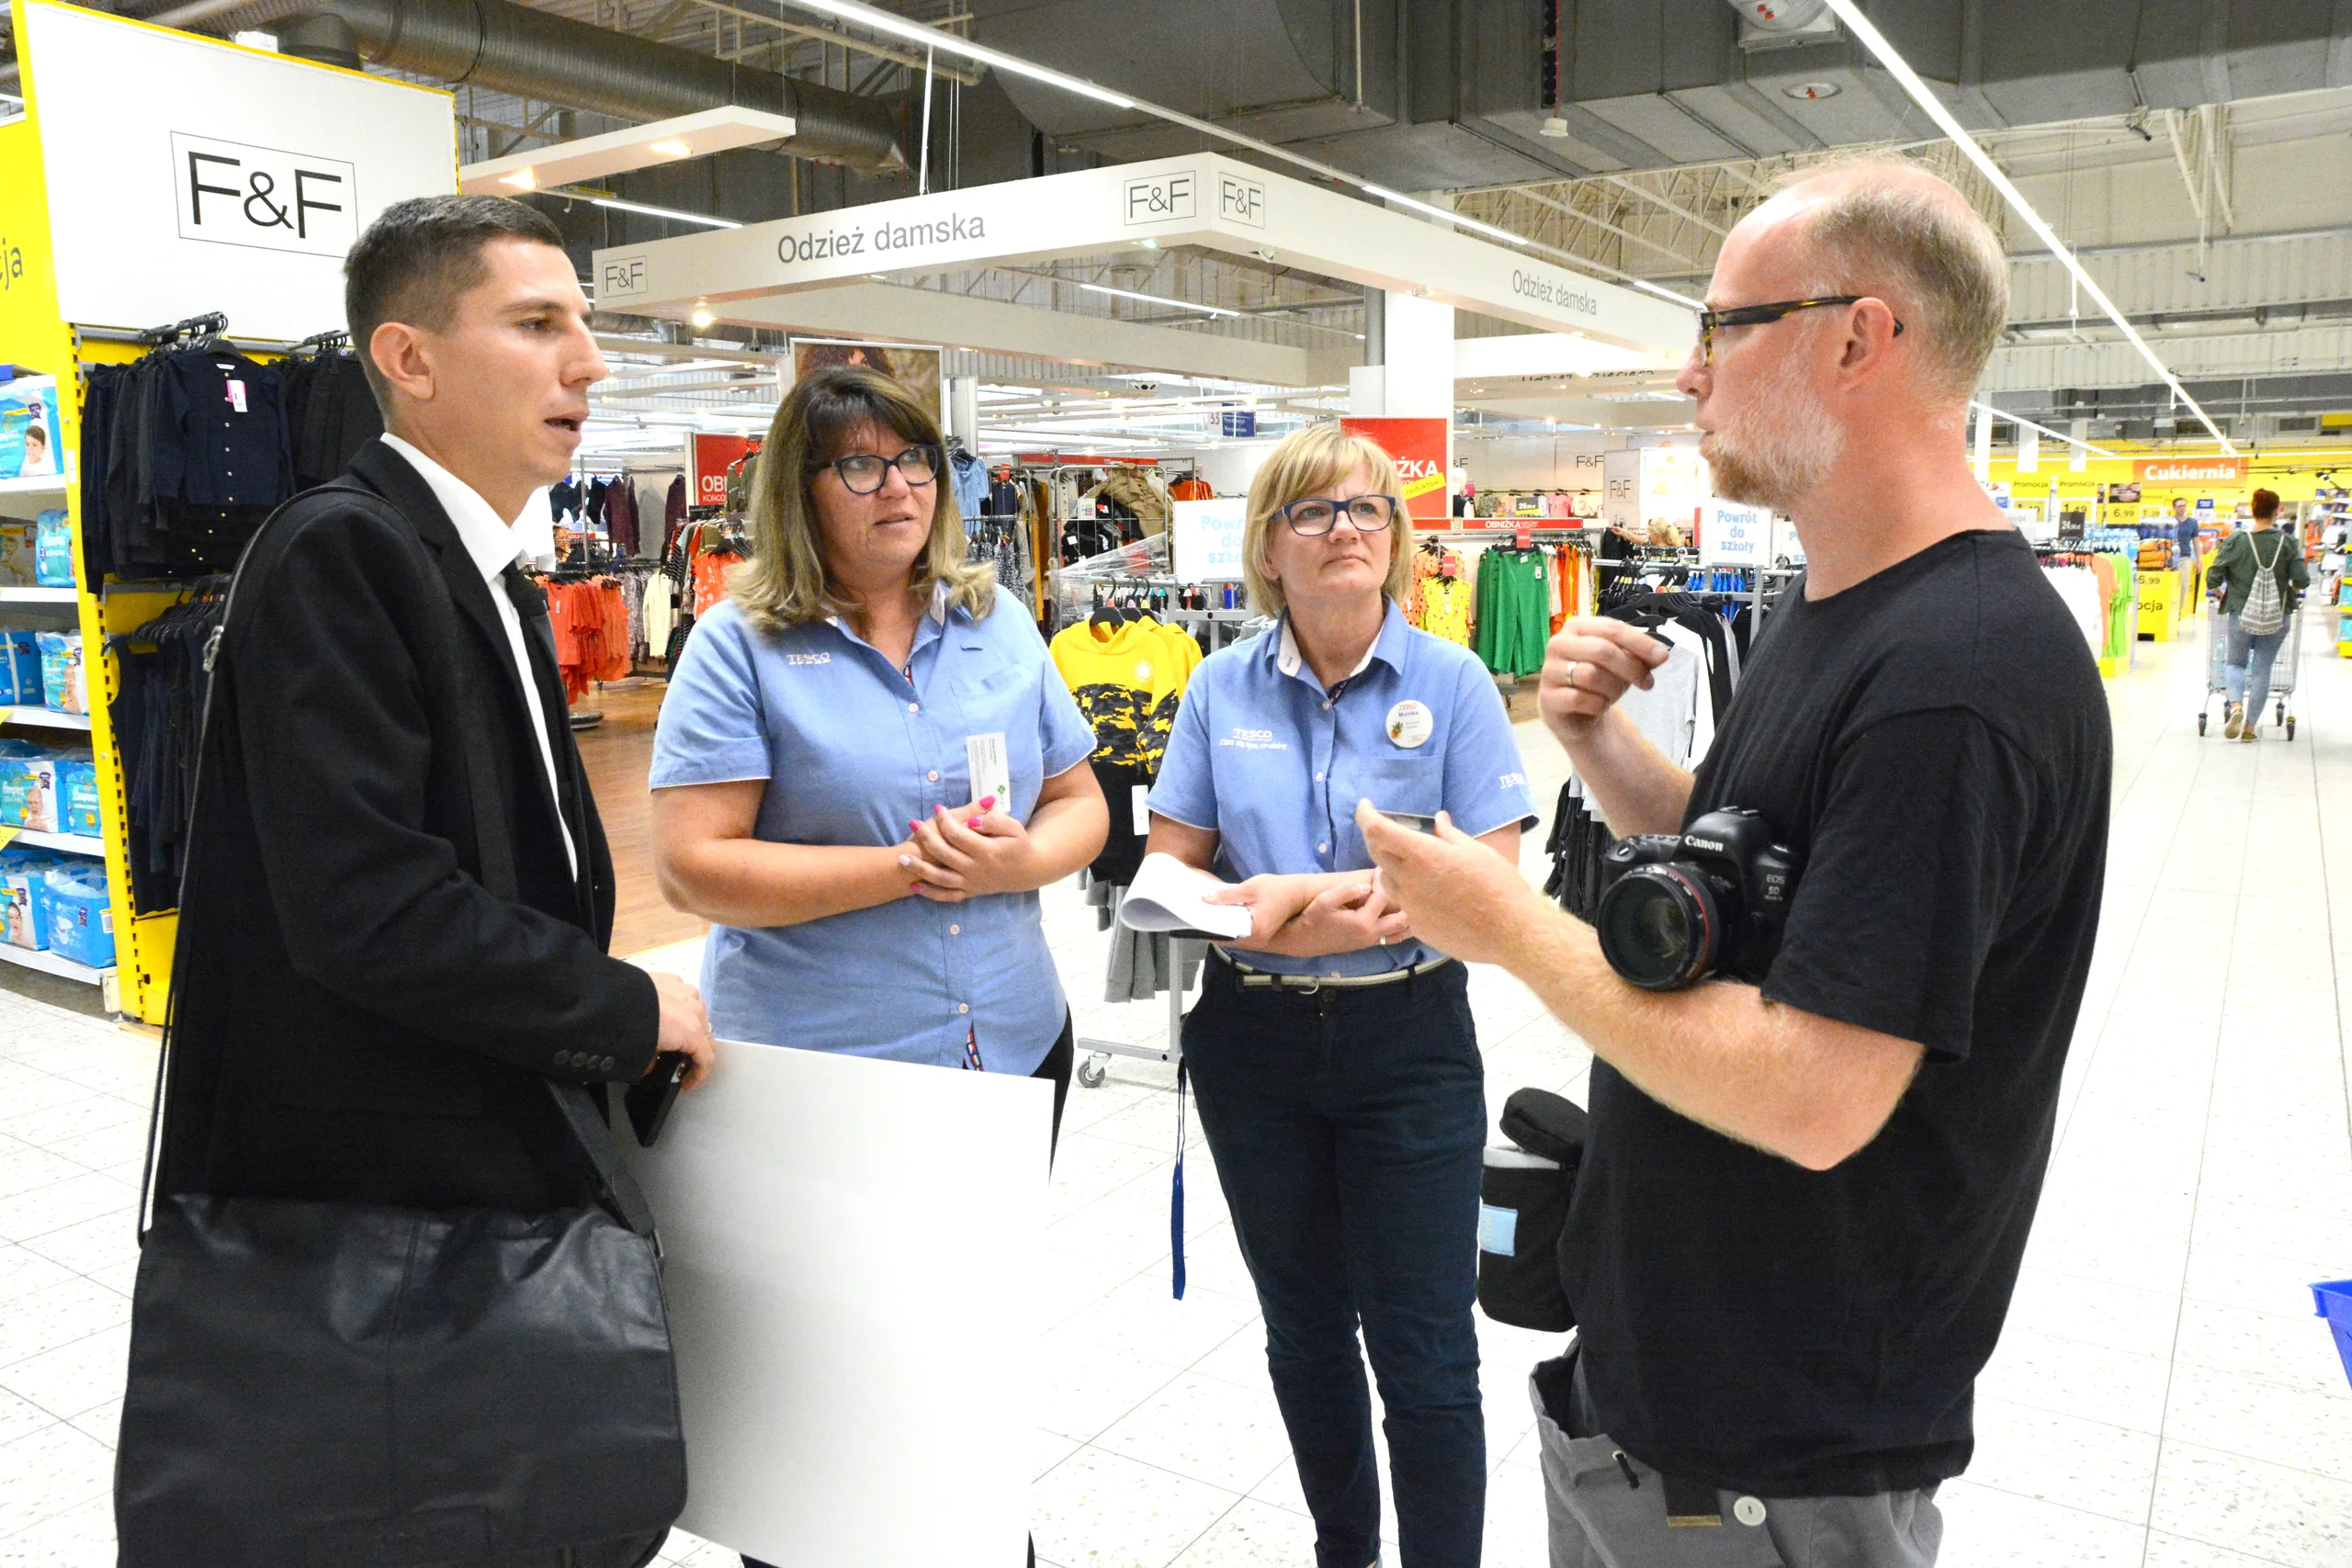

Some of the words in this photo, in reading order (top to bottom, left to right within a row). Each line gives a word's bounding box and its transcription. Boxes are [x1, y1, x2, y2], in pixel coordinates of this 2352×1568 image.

[188, 151, 342, 239] F&F
[1129, 178, 1190, 219] F&F
[1223, 180, 1261, 220] F&F
[777, 225, 865, 264] Odzież
[874, 212, 986, 252] damska
[0, 237, 23, 292] ja
[605, 262, 644, 293] F&F
[1512, 269, 1553, 303] Odzież
[1555, 283, 1597, 316] damska
[1576, 455, 1604, 468] F&F
[2144, 463, 2236, 481] Cukiernia
[1610, 479, 1631, 500] F&F
[2013, 480, 2049, 489] Promocja
[2059, 480, 2096, 489] Promocja
[1716, 510, 1757, 524] Powrót
[2113, 508, 2135, 517] 6.99
[1201, 516, 1244, 531] Powr
[1485, 520, 1521, 529] OBNIŻKA
[1729, 525, 1745, 538] do
[1221, 533, 1243, 548] do
[1721, 540, 1754, 554] szkoły
[786, 652, 831, 664] TESCO
[1233, 728, 1273, 740] TESCO
[1685, 835, 1724, 852] Canon
[1766, 874, 1786, 885] EOS
